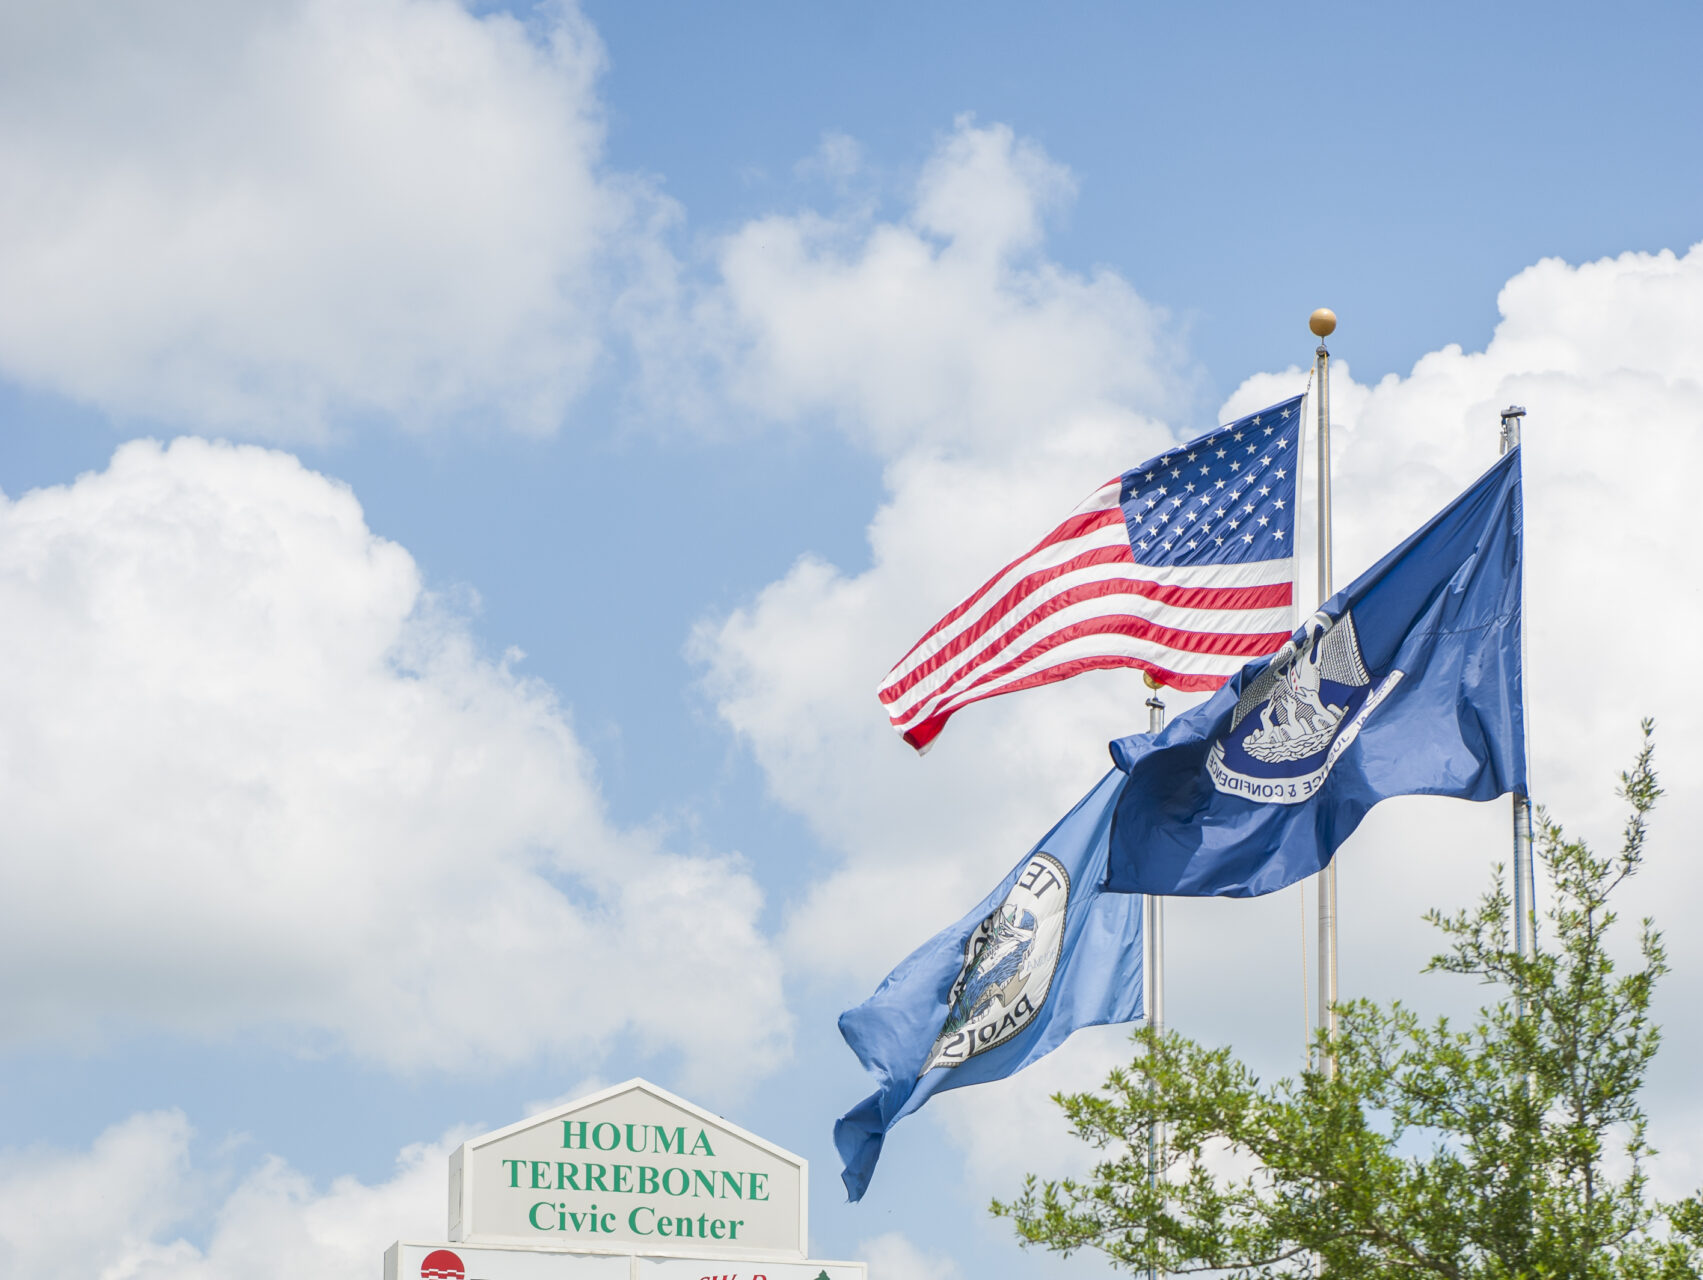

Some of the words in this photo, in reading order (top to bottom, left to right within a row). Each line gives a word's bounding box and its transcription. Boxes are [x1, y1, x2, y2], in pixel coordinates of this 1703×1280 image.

[560, 1120, 717, 1157] HOUMA
[502, 1159, 770, 1202] TERREBONNE
[529, 1201, 617, 1234] Civic
[628, 1206, 744, 1240] Center
